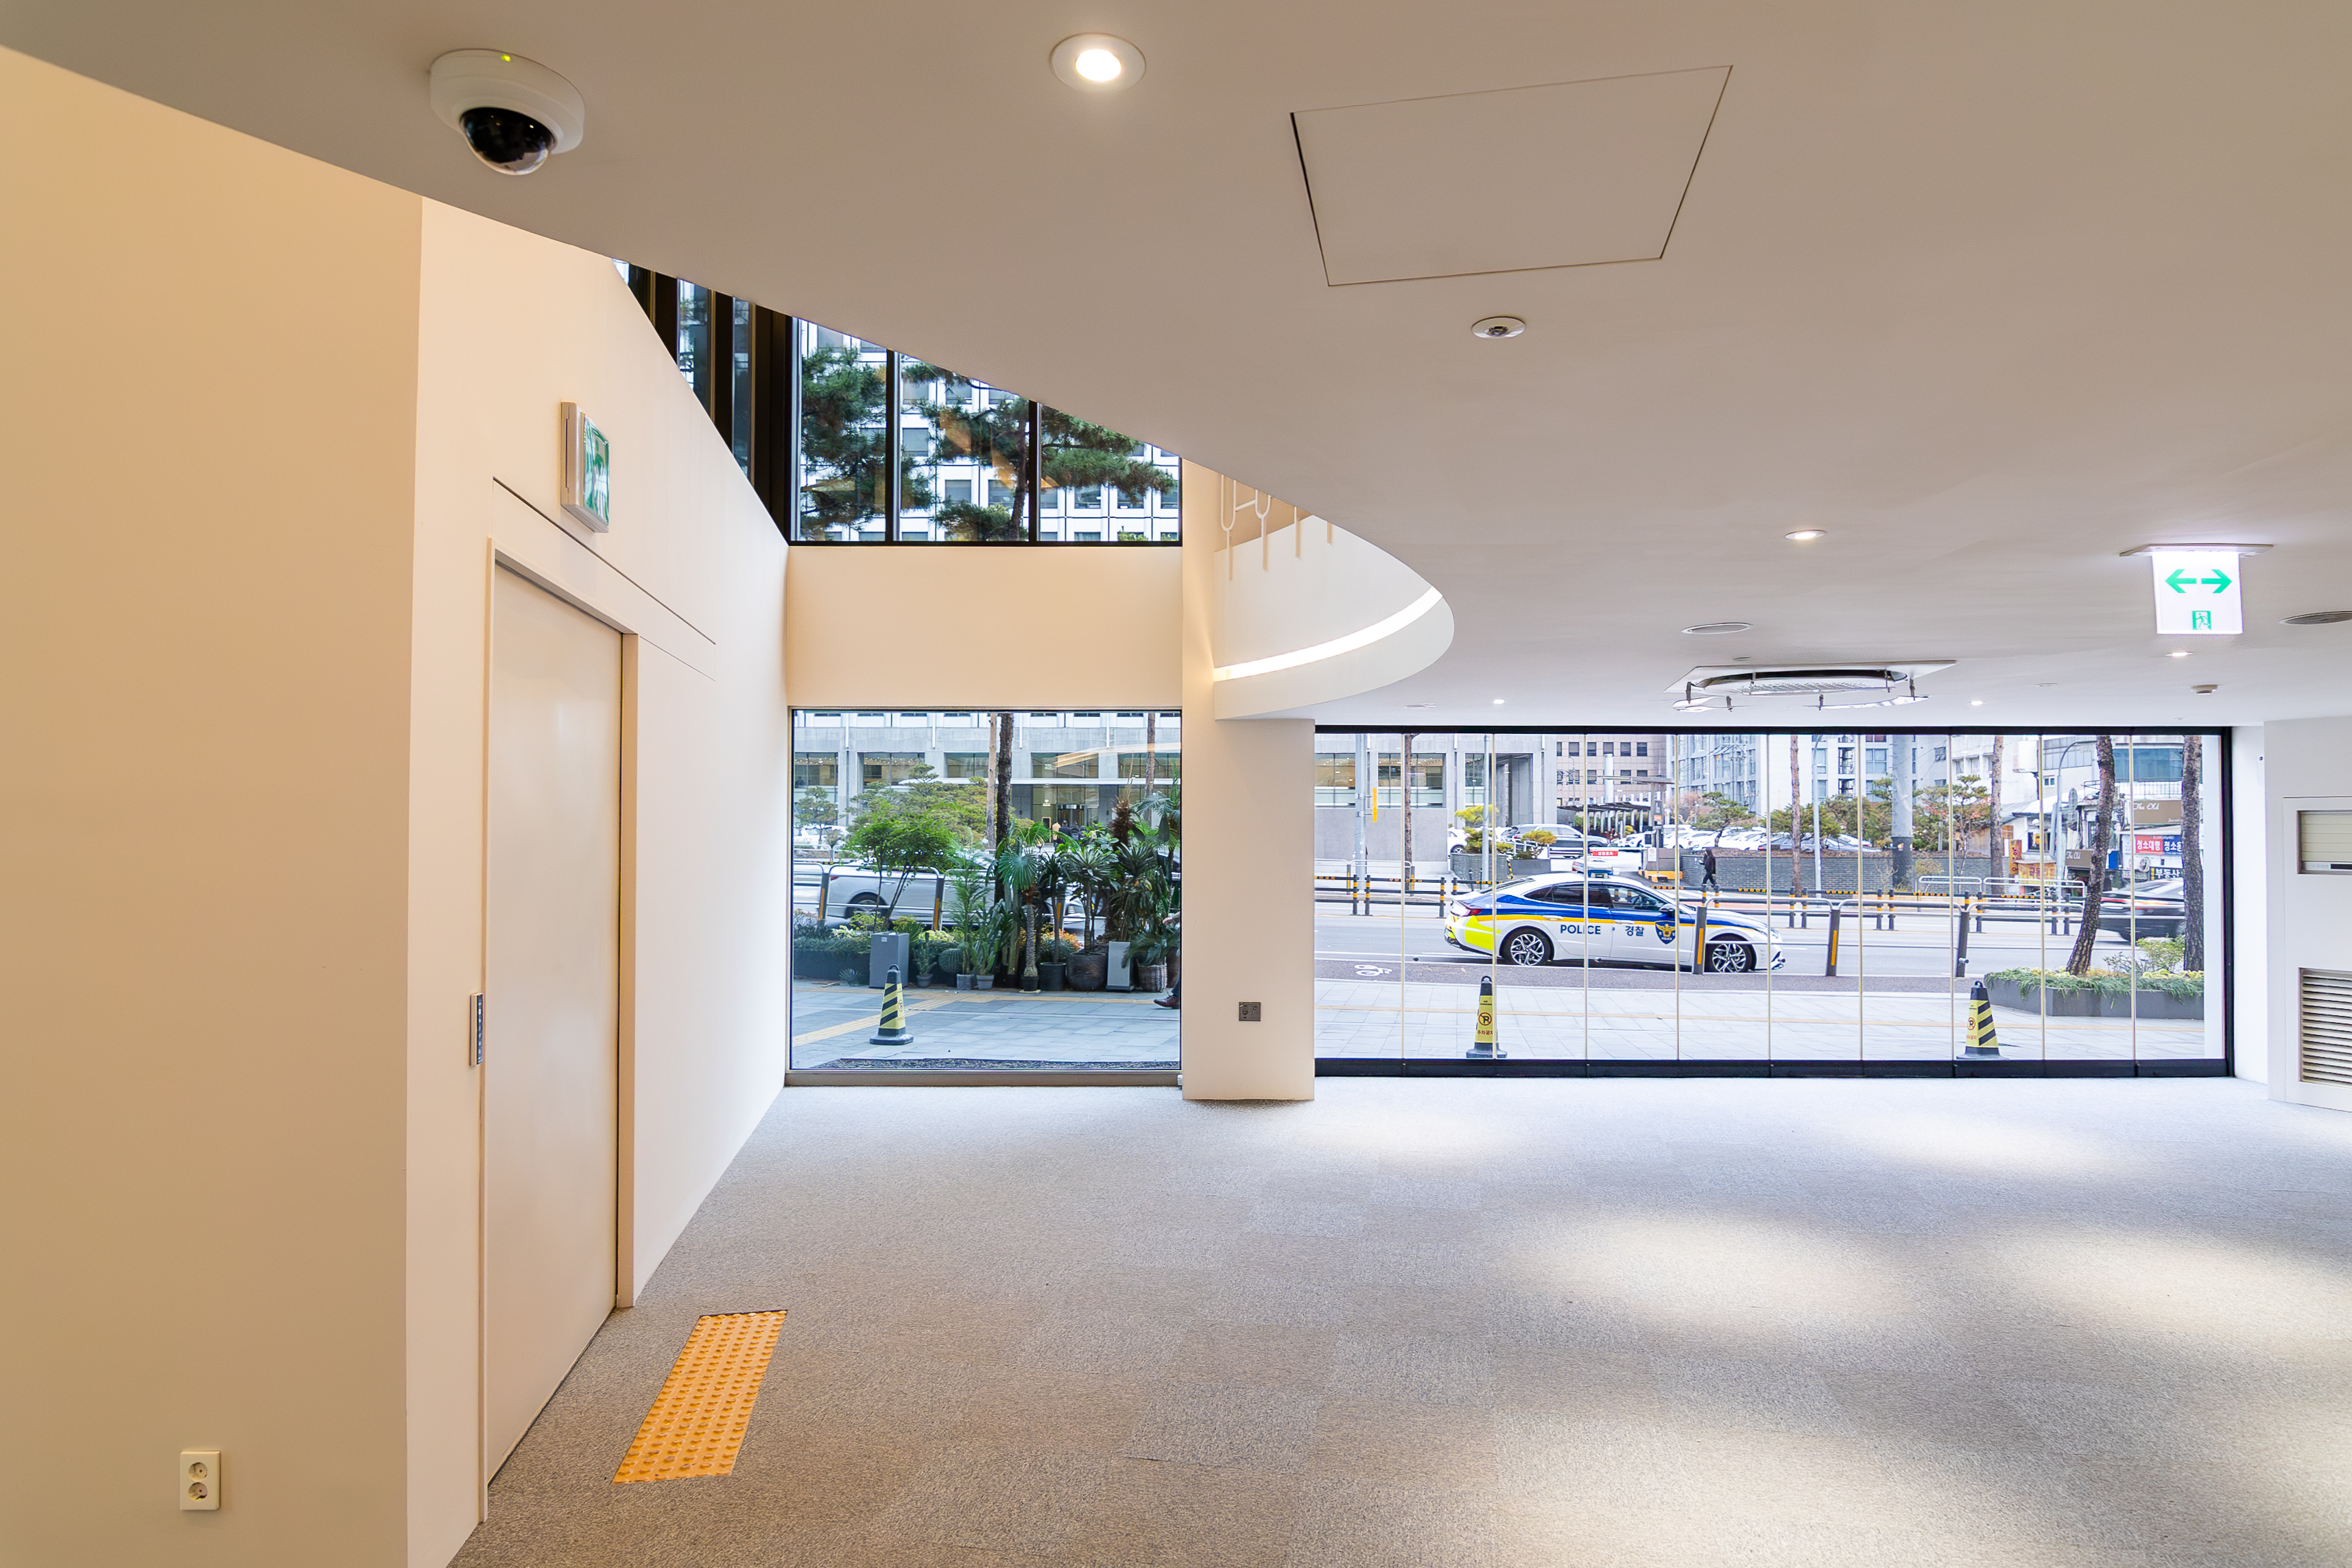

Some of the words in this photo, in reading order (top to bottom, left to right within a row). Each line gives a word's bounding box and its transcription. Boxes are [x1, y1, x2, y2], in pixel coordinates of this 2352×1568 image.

[2137, 840, 2161, 851] 청소대행
[1560, 925, 1601, 934] POLICE
[1625, 926, 1644, 936] 경찰
